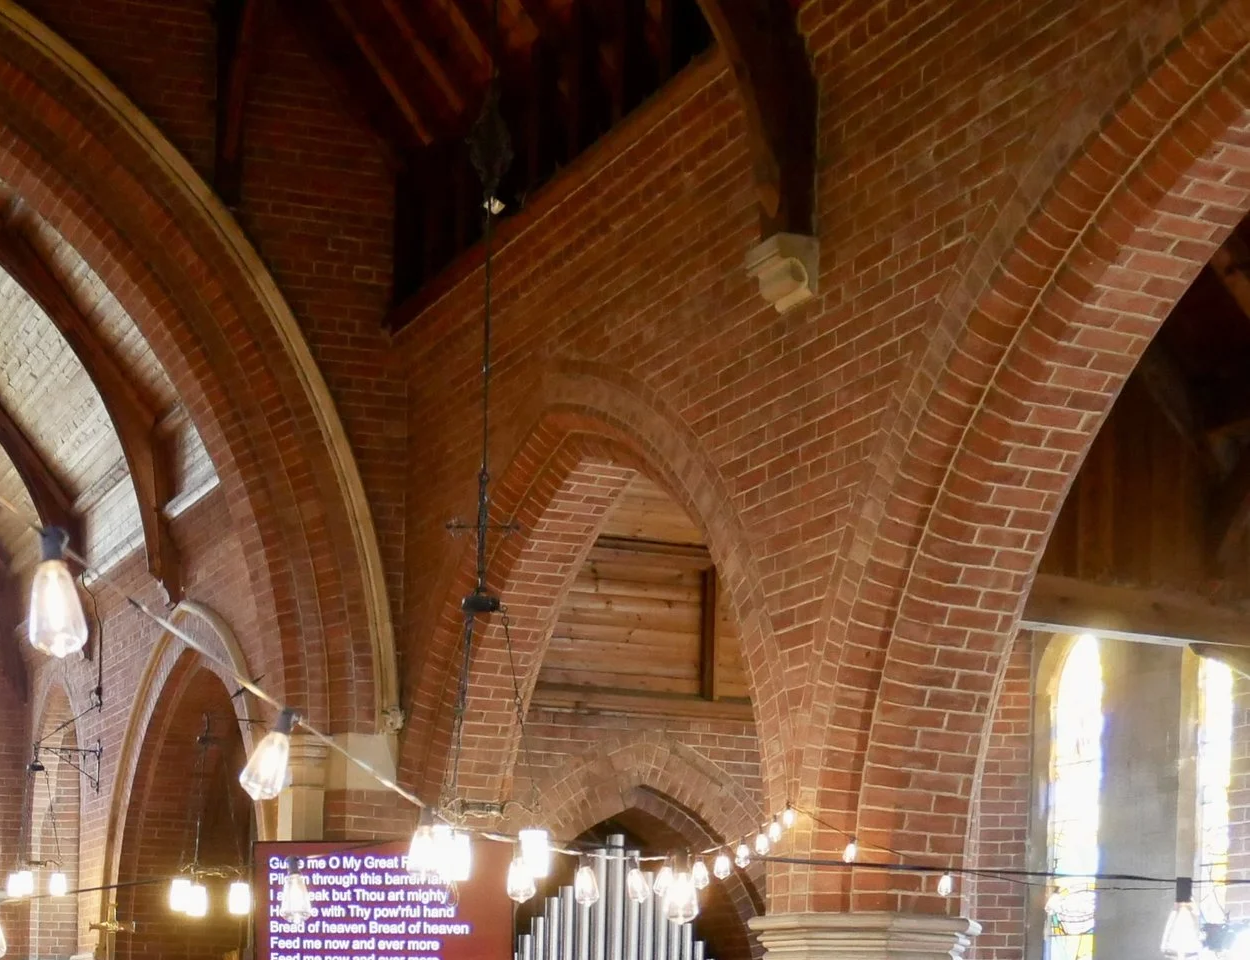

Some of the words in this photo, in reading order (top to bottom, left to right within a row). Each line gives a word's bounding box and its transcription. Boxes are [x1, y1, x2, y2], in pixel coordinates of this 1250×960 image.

[307, 859, 326, 869] me
[329, 857, 340, 869] O
[343, 857, 362, 872] My
[364, 856, 399, 869] Great
[312, 873, 358, 888] through
[360, 872, 382, 885] this
[270, 889, 274, 901] I
[332, 889, 351, 901] but
[353, 889, 385, 901] Thou
[387, 890, 404, 901] art
[407, 889, 447, 904] mighty
[321, 905, 345, 917] with
[348, 905, 371, 920] Thy
[374, 905, 420, 920] pow'rful
[423, 906, 455, 918] hand
[270, 921, 305, 933] Bread
[308, 921, 320, 933] of
[322, 921, 366, 933] heaven
[369, 921, 405, 934] Bread
[408, 921, 422, 934] of
[423, 922, 469, 934] heaven
[270, 937, 300, 949] Feed
[303, 939, 322, 949] me
[324, 940, 350, 950] now
[352, 937, 375, 950] and
[378, 940, 405, 950] ever
[407, 940, 440, 951] more
